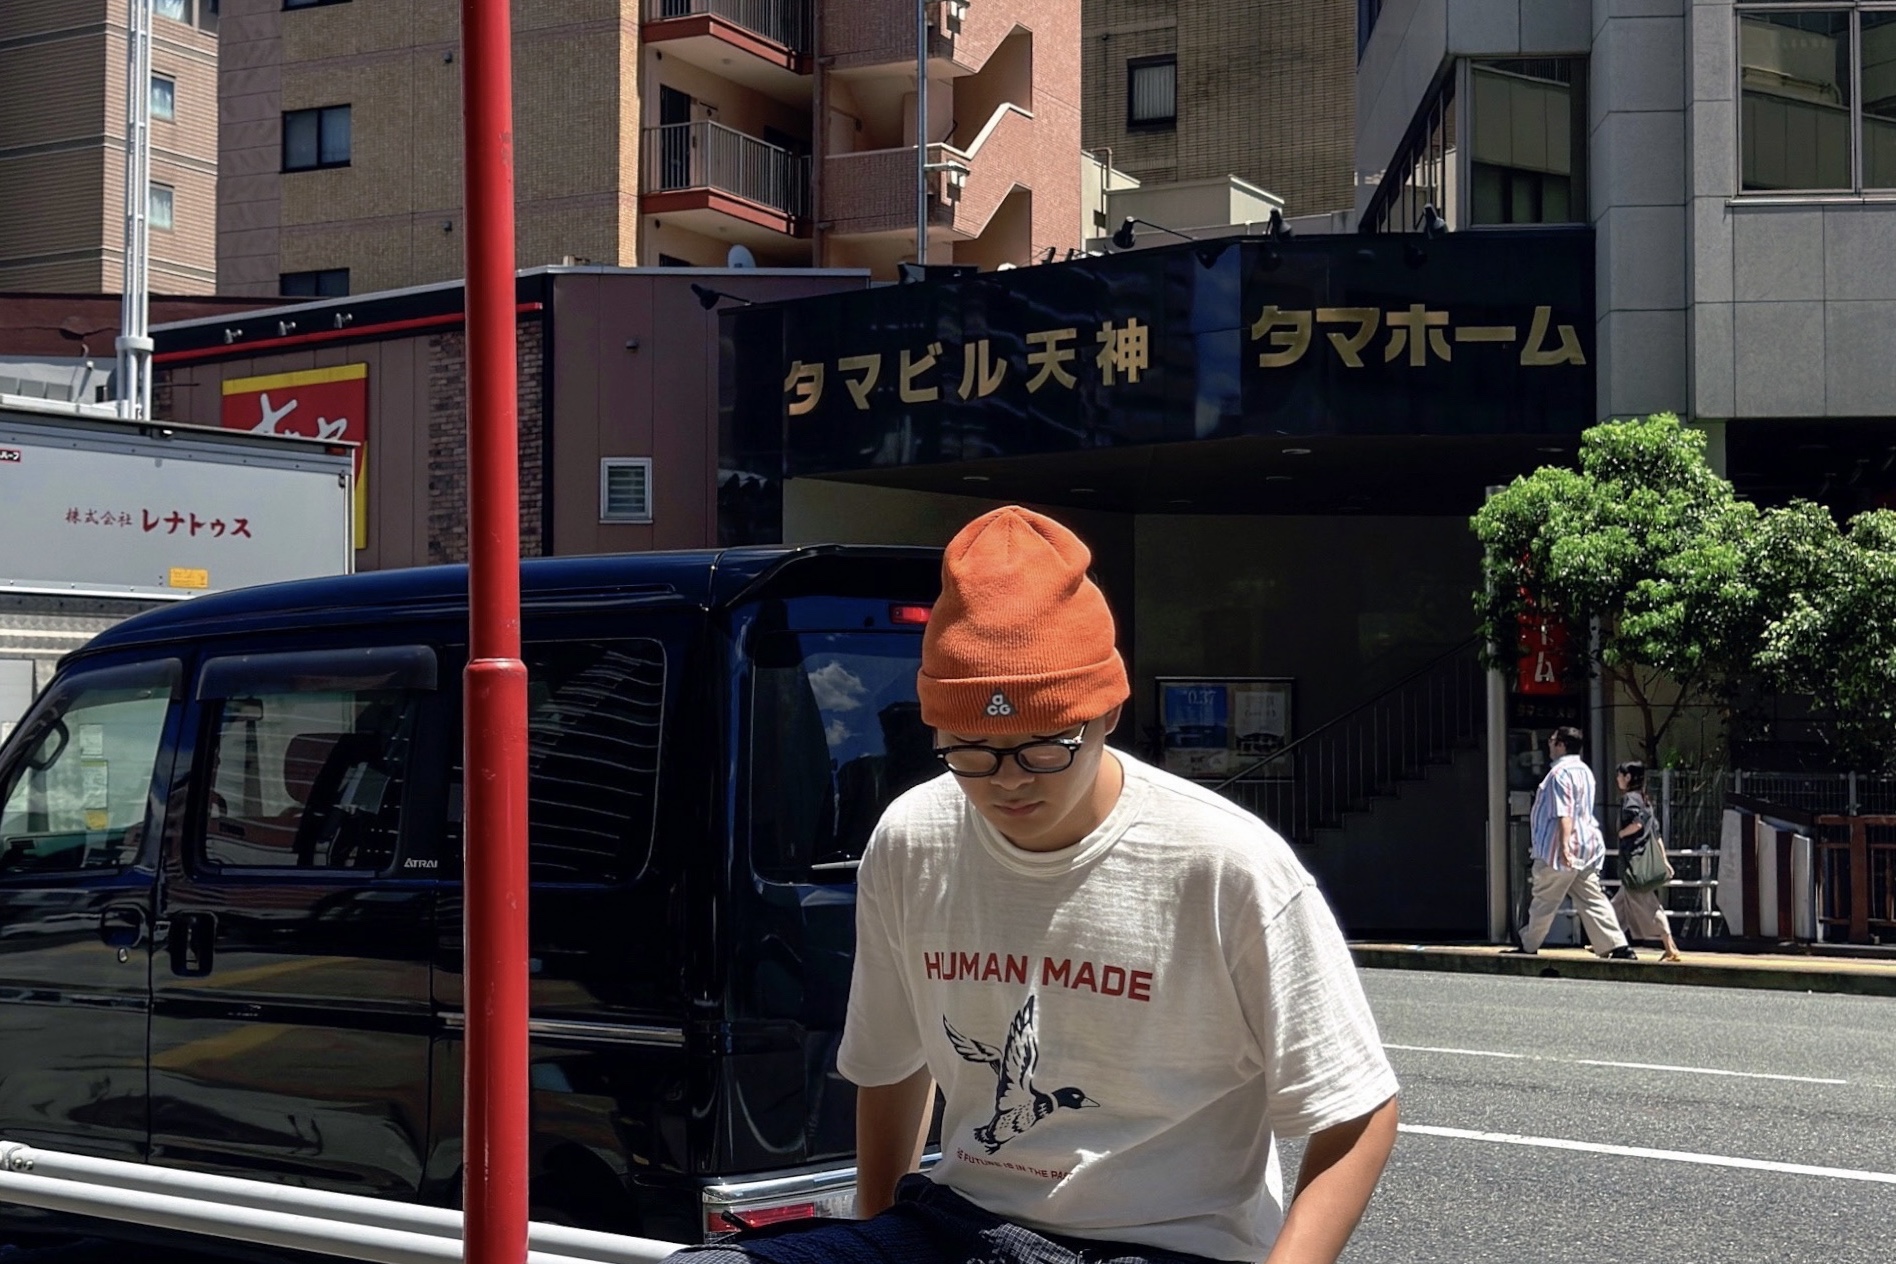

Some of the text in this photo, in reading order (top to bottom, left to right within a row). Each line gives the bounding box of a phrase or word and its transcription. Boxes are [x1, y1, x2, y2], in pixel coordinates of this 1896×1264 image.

[1251, 304, 1586, 367] タマホーム
[784, 317, 1149, 416] タマビル天神
[0, 451, 19, 460] ハーフ
[65, 507, 252, 538] 株式会社 レナトゥス
[404, 858, 438, 868] ATRAI
[924, 952, 1153, 1002] HUMAN MADE
[1027, 1167, 1048, 1178] THE
